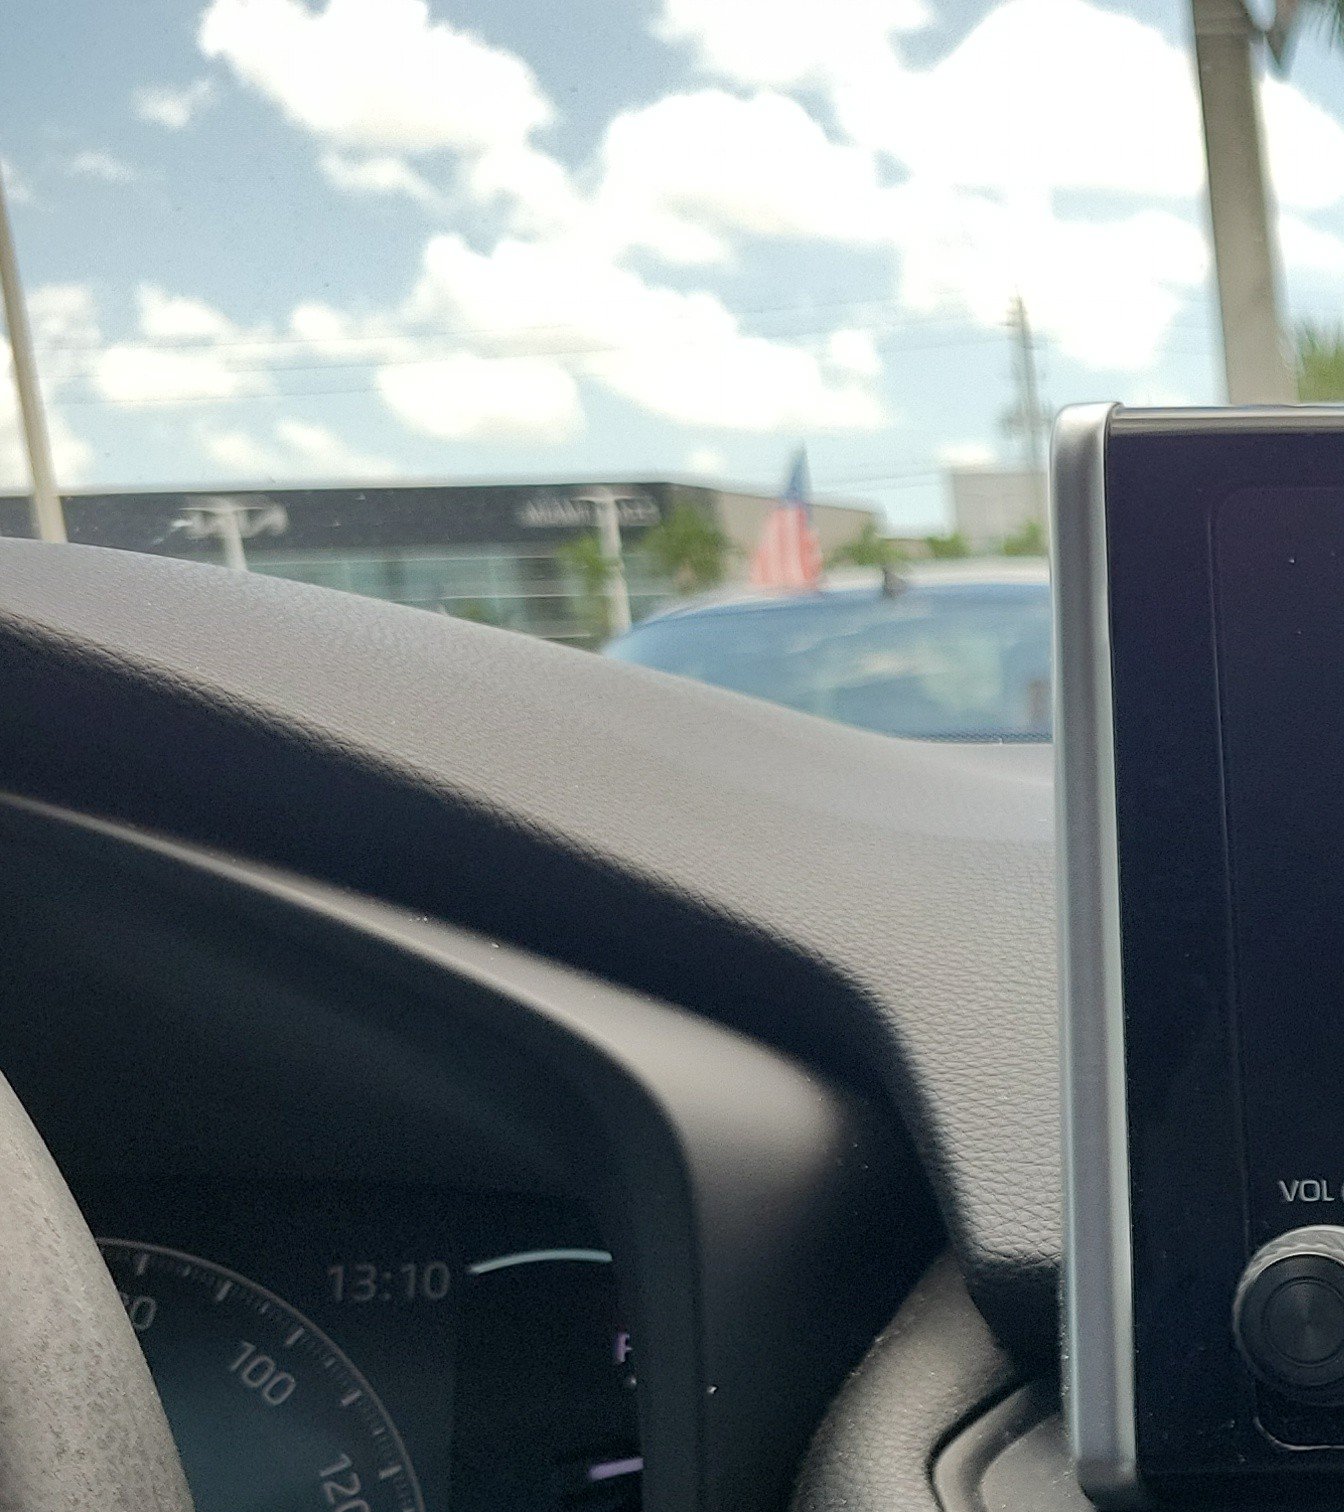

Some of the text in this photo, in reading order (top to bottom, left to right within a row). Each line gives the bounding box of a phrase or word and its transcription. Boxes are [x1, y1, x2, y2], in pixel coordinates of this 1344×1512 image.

[1278, 1178, 1334, 1203] VOL
[327, 1261, 451, 1303] 13:10
[229, 1339, 297, 1407] 100
